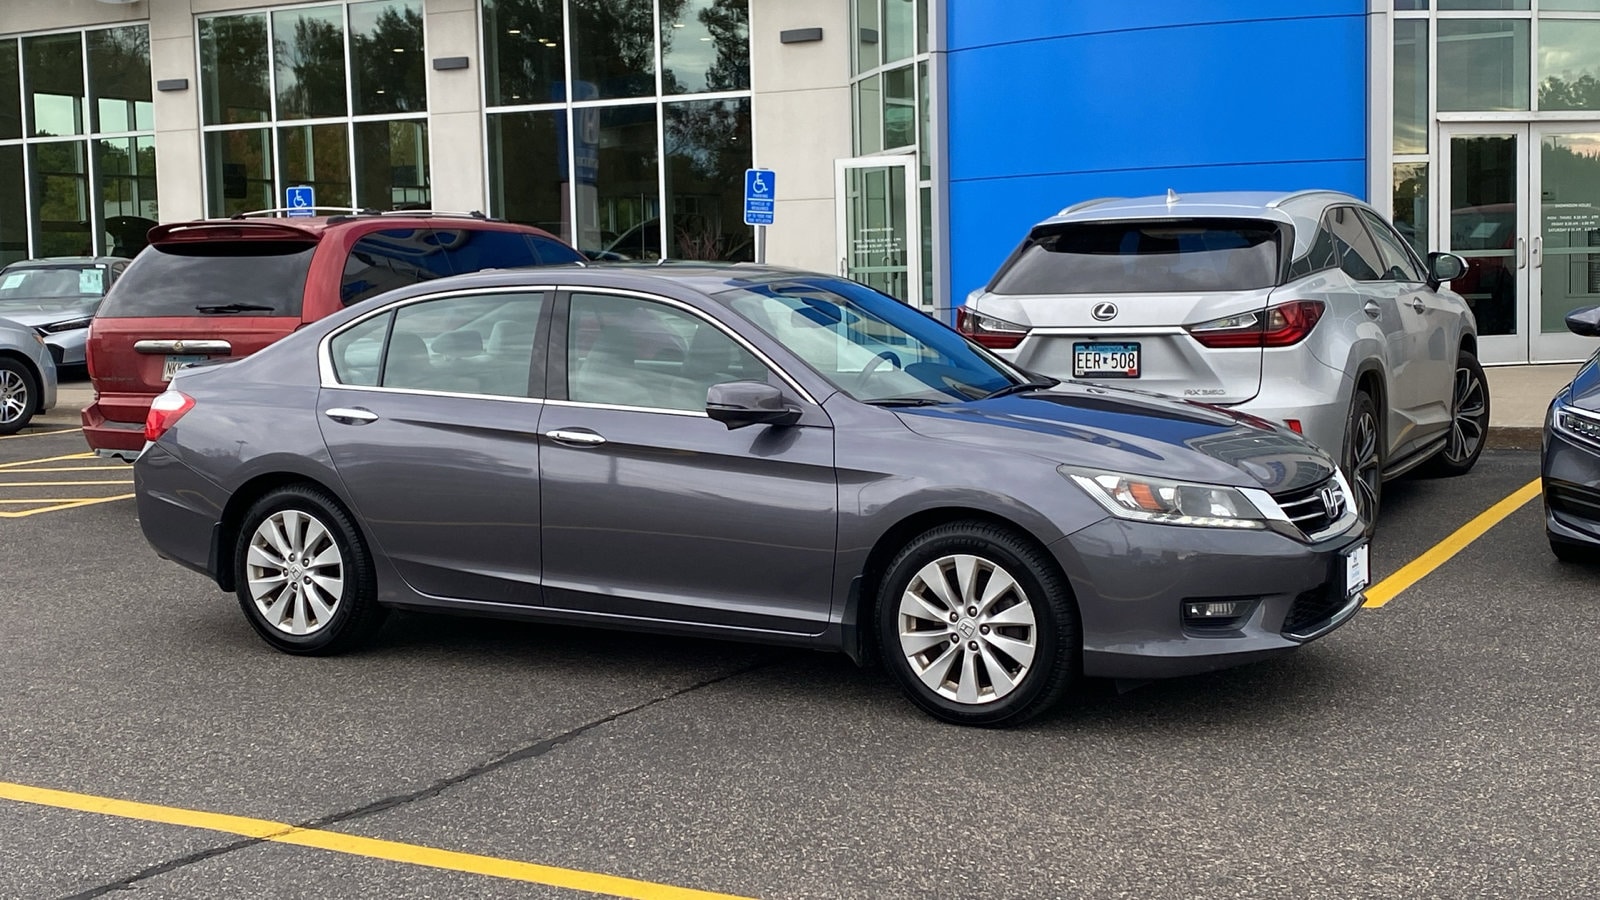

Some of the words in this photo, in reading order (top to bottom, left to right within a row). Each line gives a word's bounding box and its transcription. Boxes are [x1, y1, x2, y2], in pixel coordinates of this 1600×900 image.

[1077, 352, 1101, 369] EER
[1111, 352, 1135, 369] 508
[934, 538, 987, 549] MICHELIN
